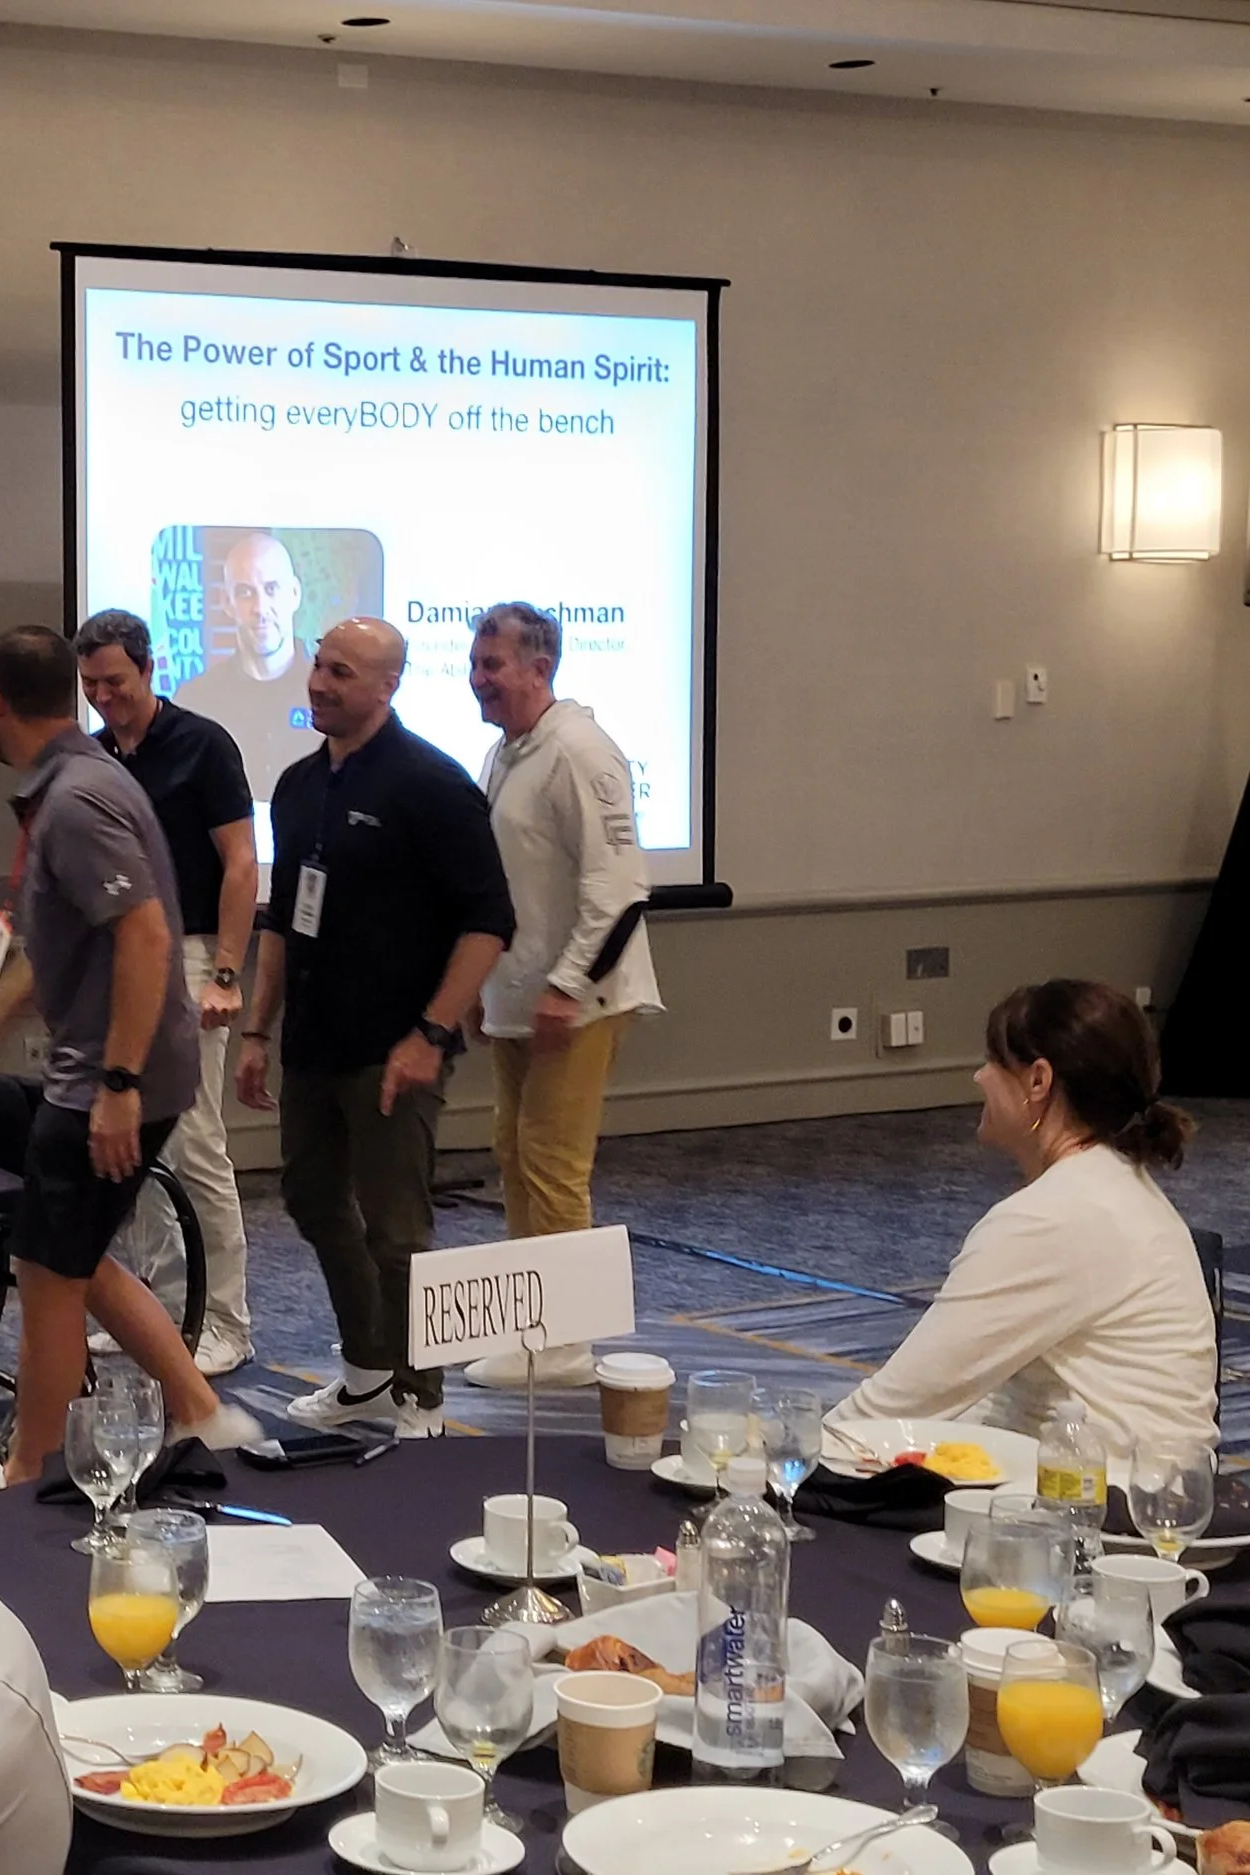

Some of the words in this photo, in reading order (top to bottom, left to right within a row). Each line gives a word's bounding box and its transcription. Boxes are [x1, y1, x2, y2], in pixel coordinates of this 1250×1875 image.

[115, 331, 173, 362] The
[182, 335, 278, 368] Power
[287, 339, 315, 369] of
[323, 342, 401, 377] Sport
[409, 347, 429, 373] &
[437, 348, 481, 376] the
[491, 350, 586, 380] Human
[594, 354, 670, 386] Spirit:
[180, 396, 276, 431] getting
[286, 400, 439, 433] everyBODY
[448, 404, 485, 432] off
[491, 408, 529, 433] the
[537, 409, 615, 436] bench
[161, 591, 203, 621] KEE
[423, 1269, 544, 1349] RESERVED
[724, 1605, 746, 1737] smartwater
